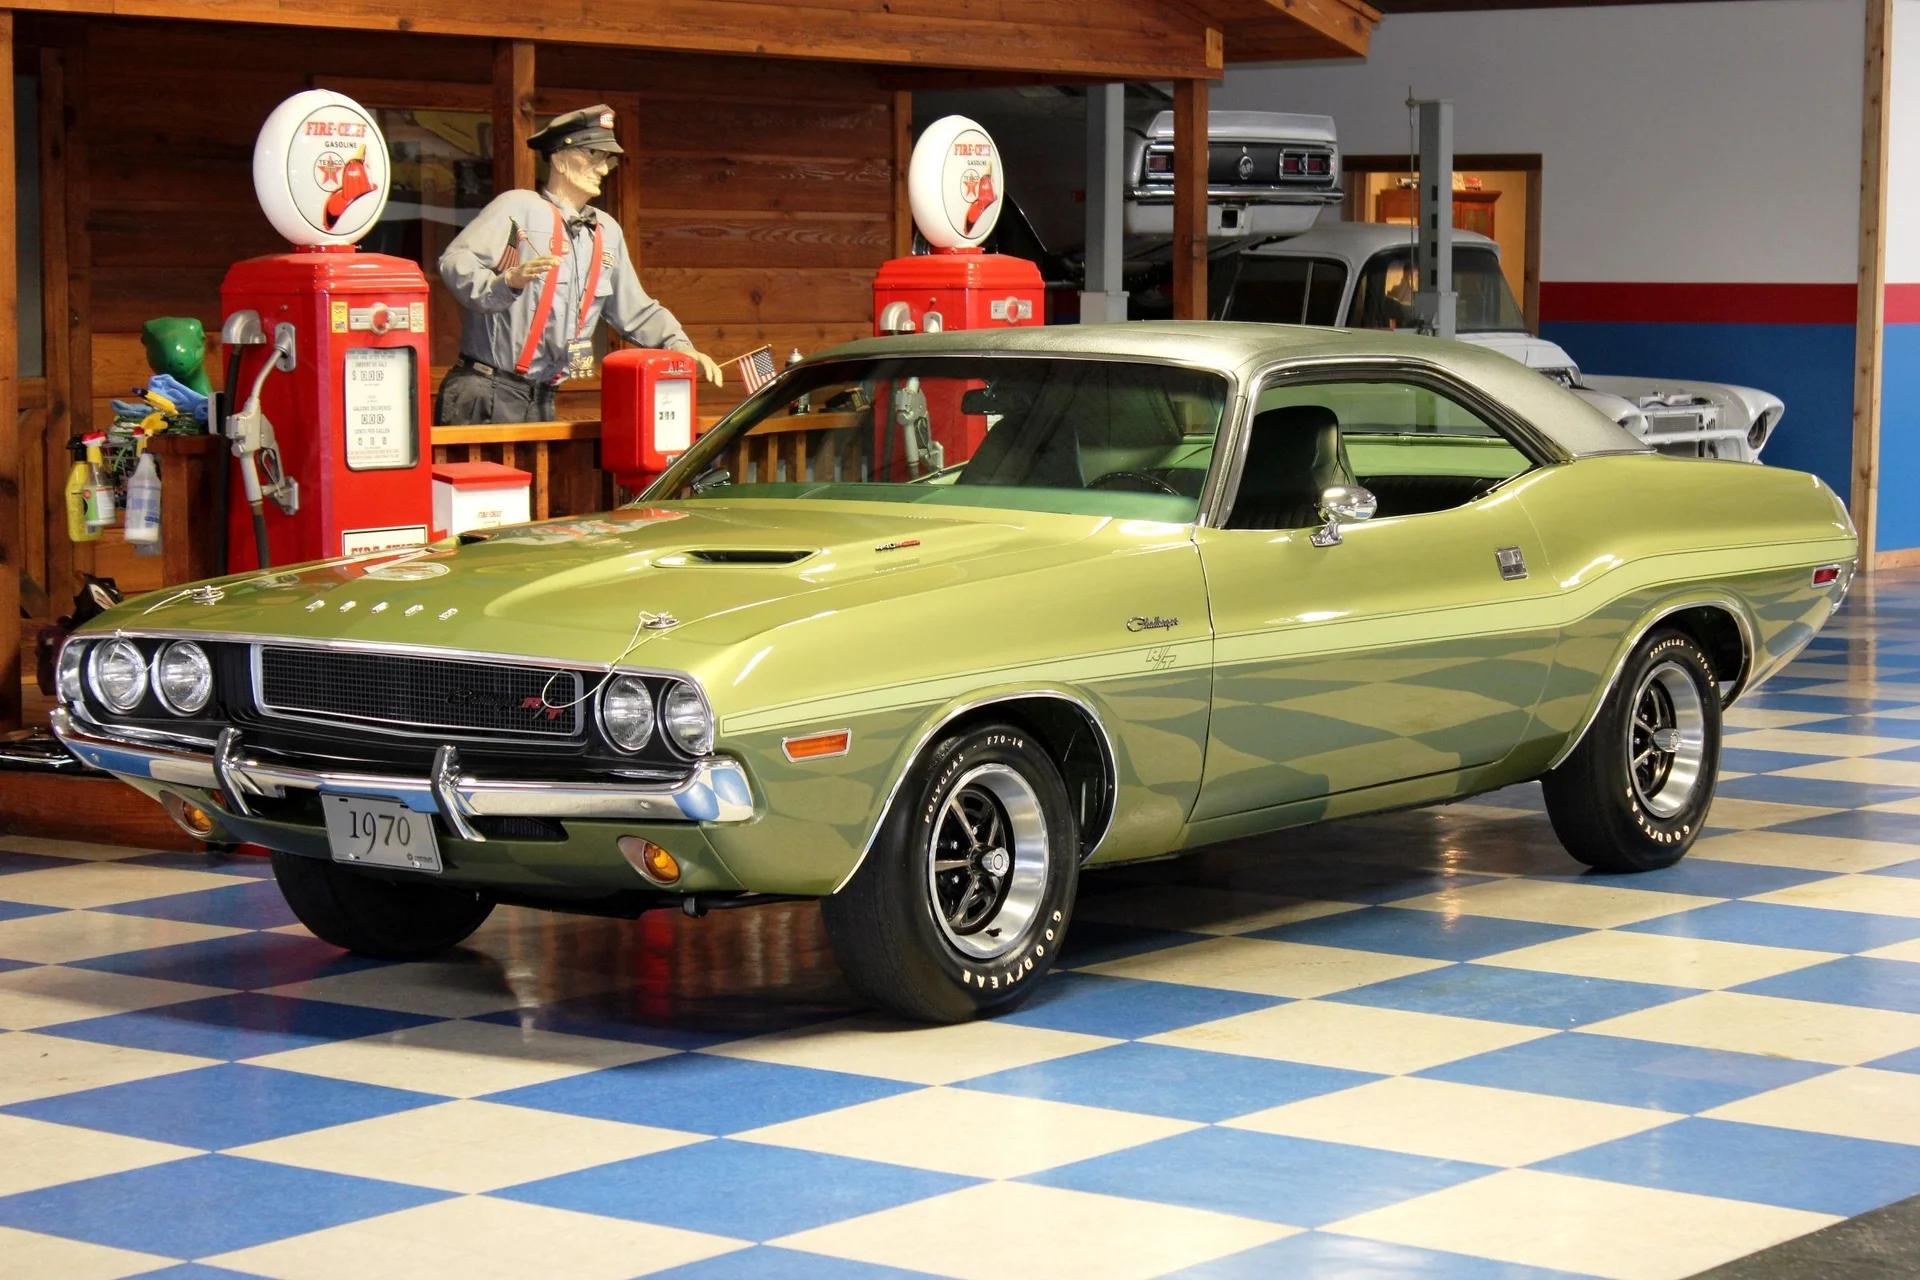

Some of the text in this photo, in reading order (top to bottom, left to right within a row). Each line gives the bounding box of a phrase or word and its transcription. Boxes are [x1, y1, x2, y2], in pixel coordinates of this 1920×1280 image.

[324, 140, 357, 149] GASOLINE
[1126, 615, 1178, 632] Challenger
[1145, 645, 1177, 671] R/T
[521, 696, 565, 720] R/T
[924, 735, 1024, 824] POLYGLAS F70-14
[1626, 786, 1690, 843] GOODYEAR
[349, 811, 411, 854] 1970
[962, 909, 1062, 989] GOODYEAR
